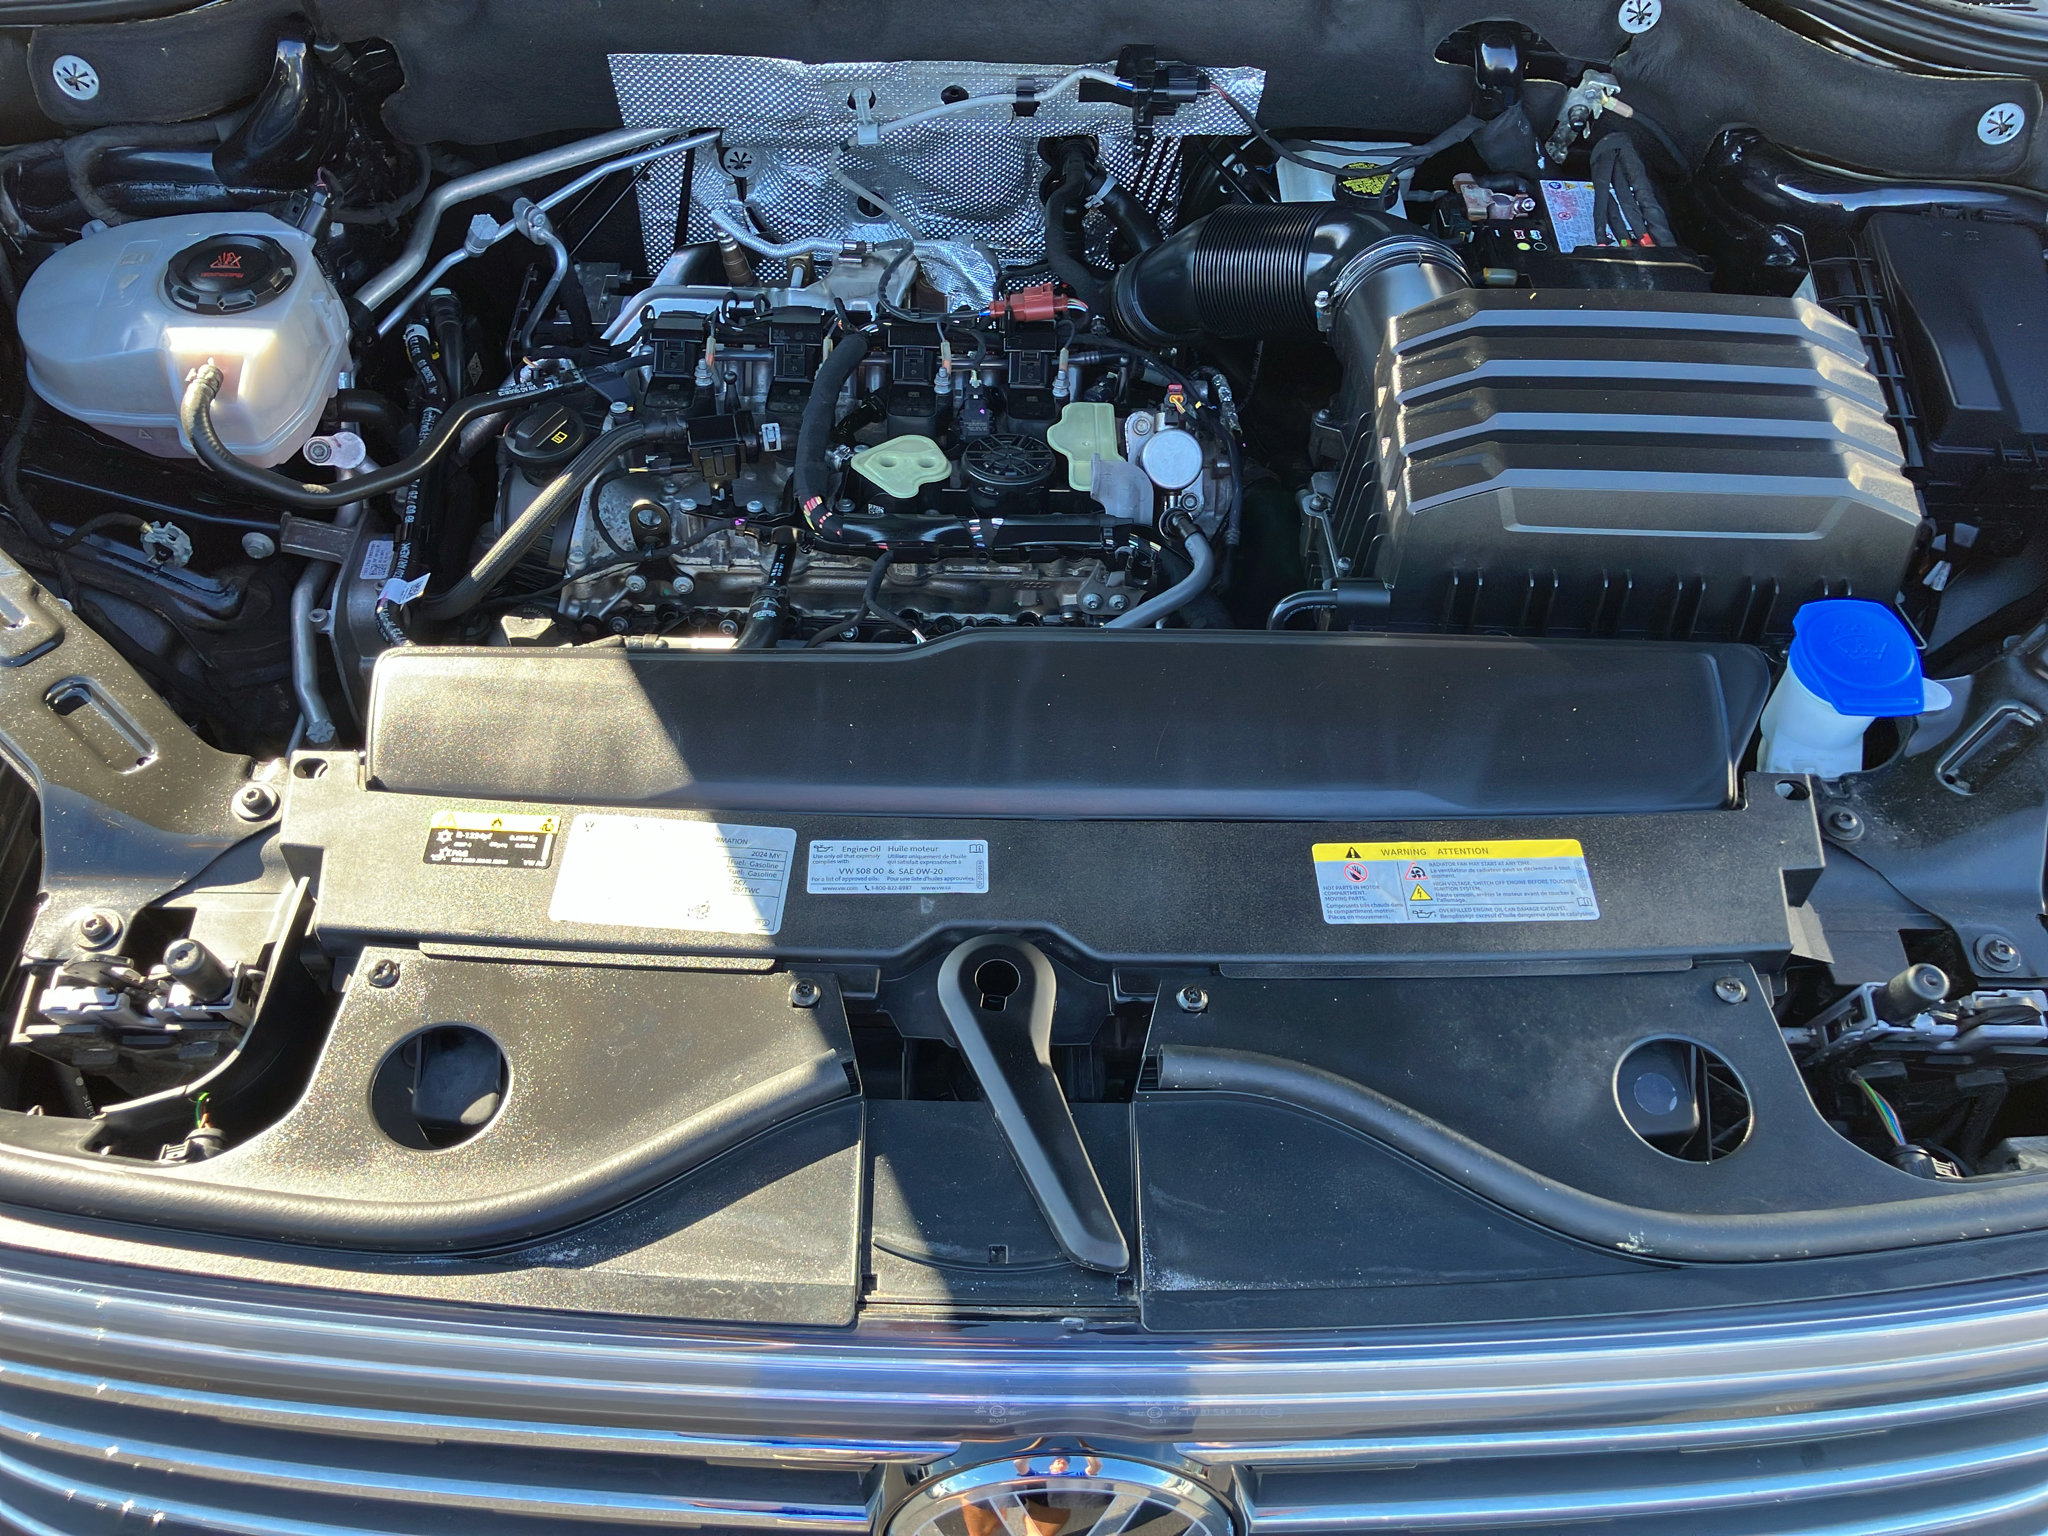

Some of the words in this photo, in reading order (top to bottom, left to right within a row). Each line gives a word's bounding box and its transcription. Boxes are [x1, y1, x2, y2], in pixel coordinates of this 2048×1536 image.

[842, 846, 869, 854] Engine
[1380, 848, 1426, 856] WARNING
[750, 861, 779, 869] Gasoline
[747, 870, 778, 878] Gasoline
